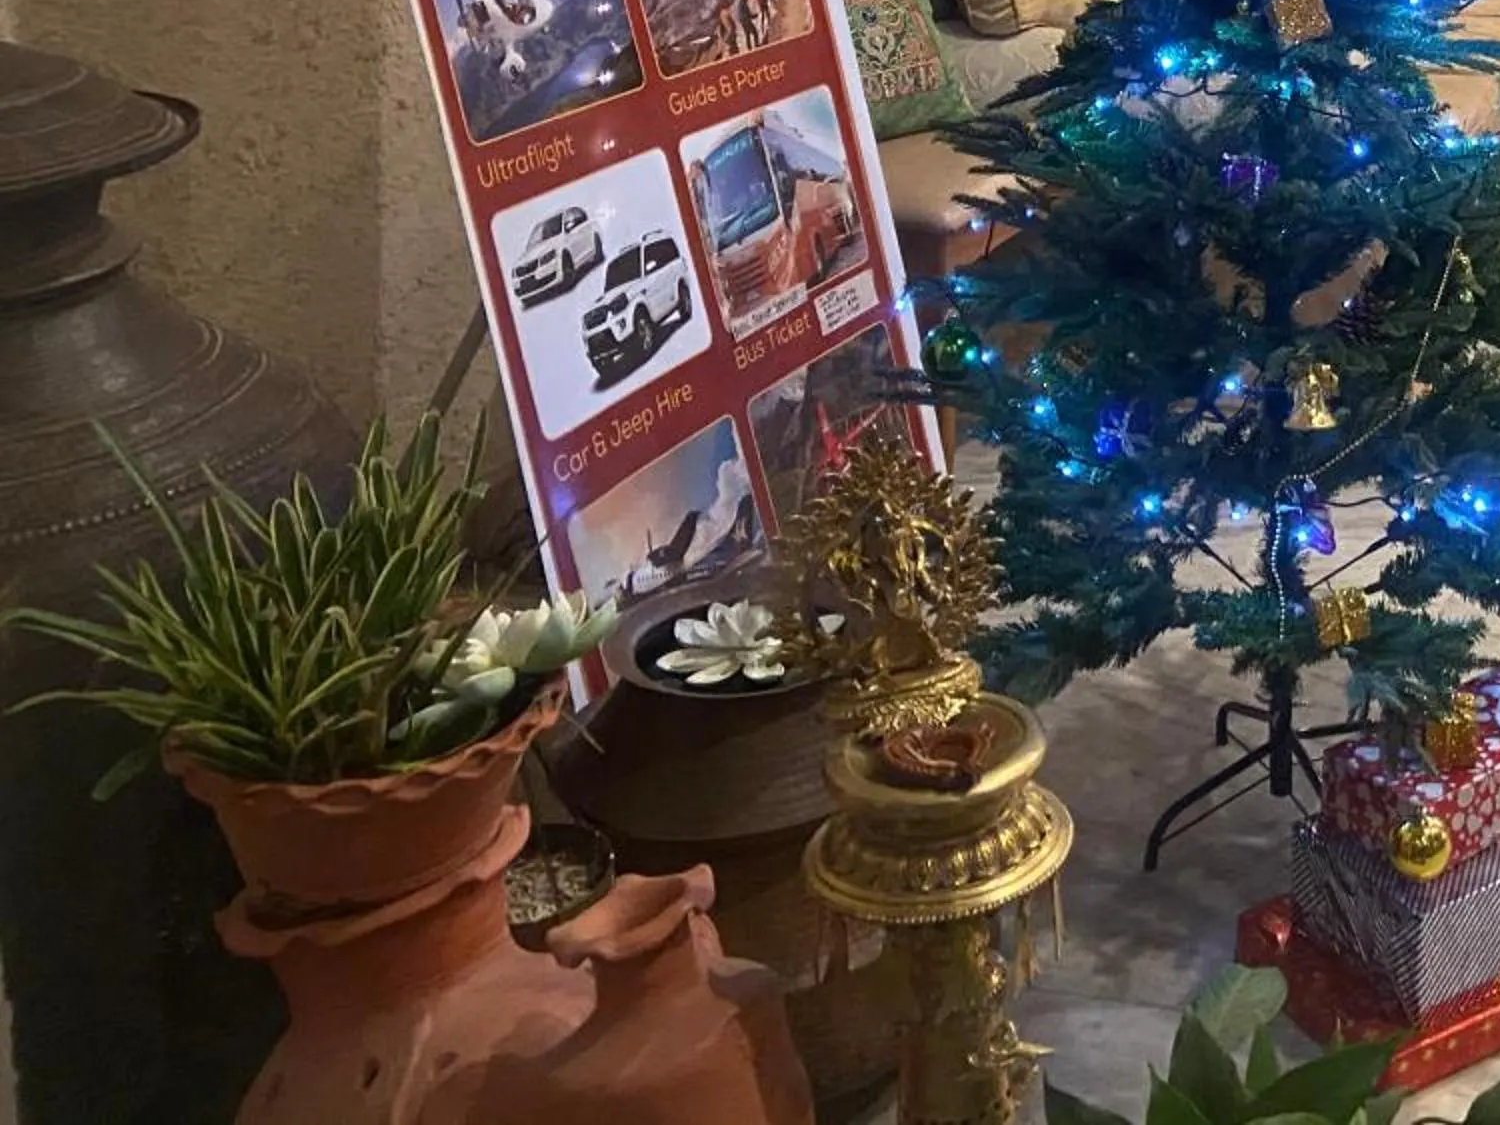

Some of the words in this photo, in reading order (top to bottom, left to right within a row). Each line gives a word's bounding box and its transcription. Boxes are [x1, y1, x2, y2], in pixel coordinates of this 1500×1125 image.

[667, 82, 718, 117] Guide
[720, 74, 735, 98] &
[736, 58, 788, 92] Porter
[476, 133, 576, 189] Ultraflight
[732, 342, 765, 371] Bus
[766, 312, 812, 355] Ticket
[552, 447, 590, 483] Car
[591, 431, 607, 459] &
[609, 405, 655, 447] Jeep
[655, 381, 694, 418] Hire
